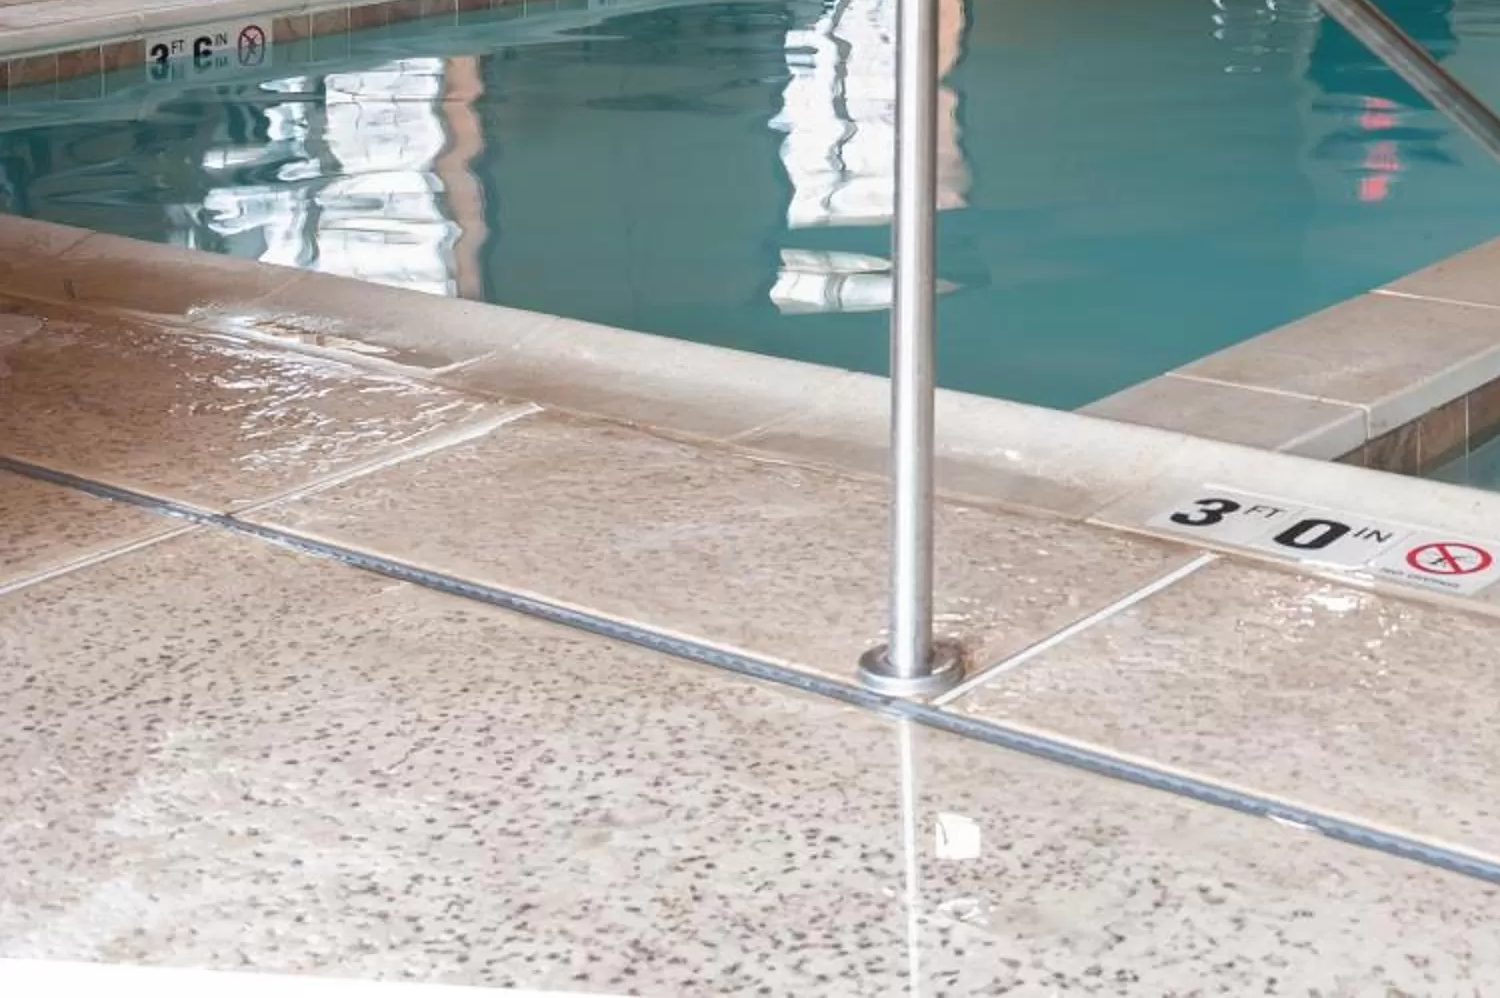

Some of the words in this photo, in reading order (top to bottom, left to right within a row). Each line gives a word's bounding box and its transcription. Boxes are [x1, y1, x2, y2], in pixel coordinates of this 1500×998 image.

[171, 40, 184, 54] FT
[215, 33, 228, 46] IN
[1169, 498, 1241, 526] 3
[1244, 505, 1283, 519] FT
[1273, 519, 1351, 549] 0
[1353, 527, 1393, 543] IN
